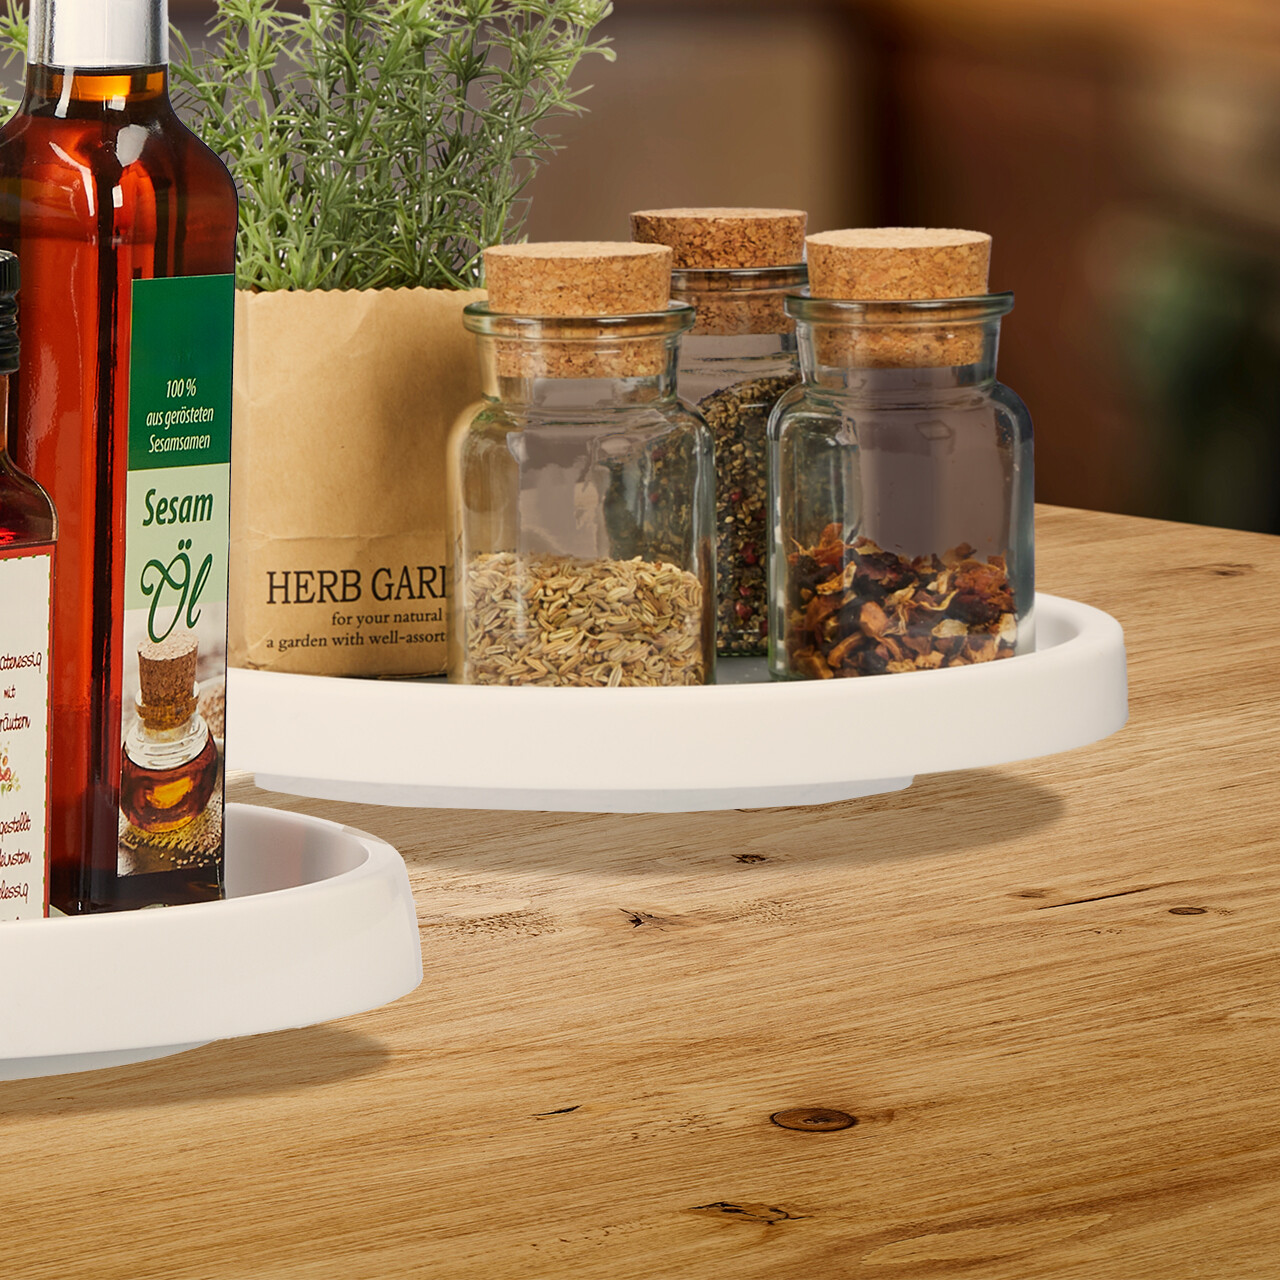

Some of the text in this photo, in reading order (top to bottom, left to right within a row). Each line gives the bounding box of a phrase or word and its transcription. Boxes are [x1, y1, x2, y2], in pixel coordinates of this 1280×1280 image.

[165, 376, 197, 400] 100 %
[146, 403, 214, 430] aus gerösteten
[148, 432, 211, 454] Sesamsamen
[142, 487, 214, 527] Sesam
[140, 538, 213, 643] Öl
[266, 568, 362, 604] HERB
[331, 607, 444, 629] for your natural
[266, 629, 447, 653] a garden with well-assort
[3, 685, 16, 700] mit
